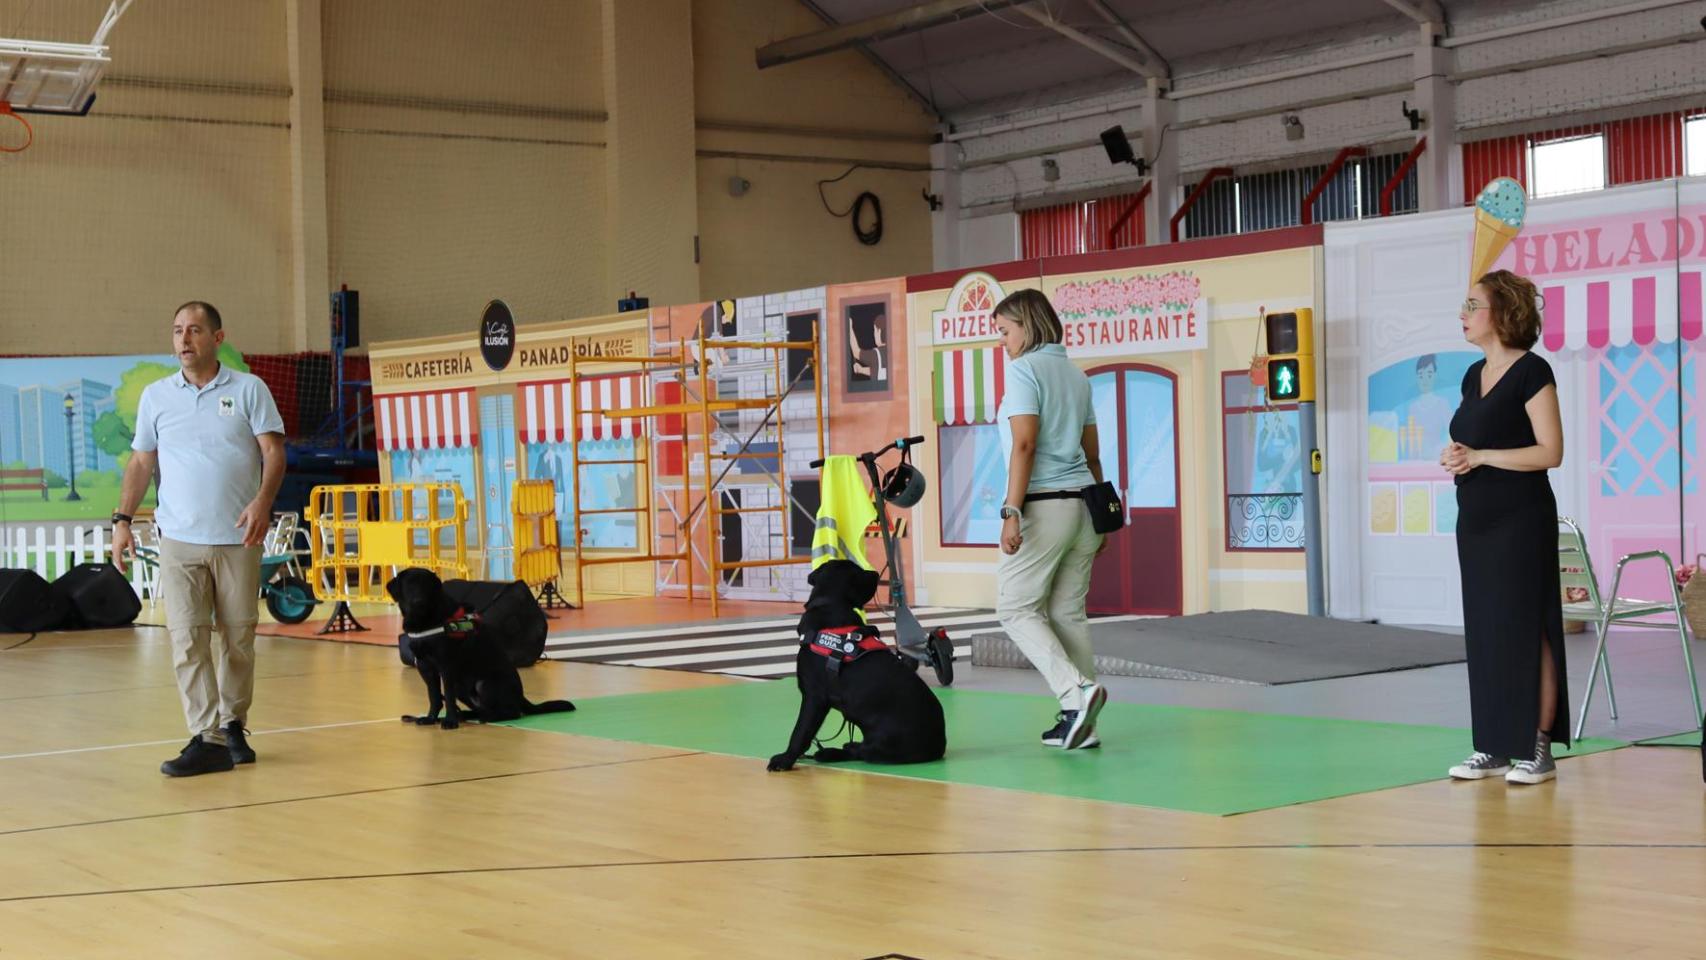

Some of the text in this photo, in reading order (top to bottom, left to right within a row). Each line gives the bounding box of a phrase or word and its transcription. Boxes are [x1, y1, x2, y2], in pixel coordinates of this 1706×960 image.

[1512, 214, 1706, 275] HELAD
[942, 314, 998, 339] PIZZER
[1065, 313, 1196, 346] ESTAURANTE
[405, 336, 602, 378] CAFETERÍA PANADRÍA
